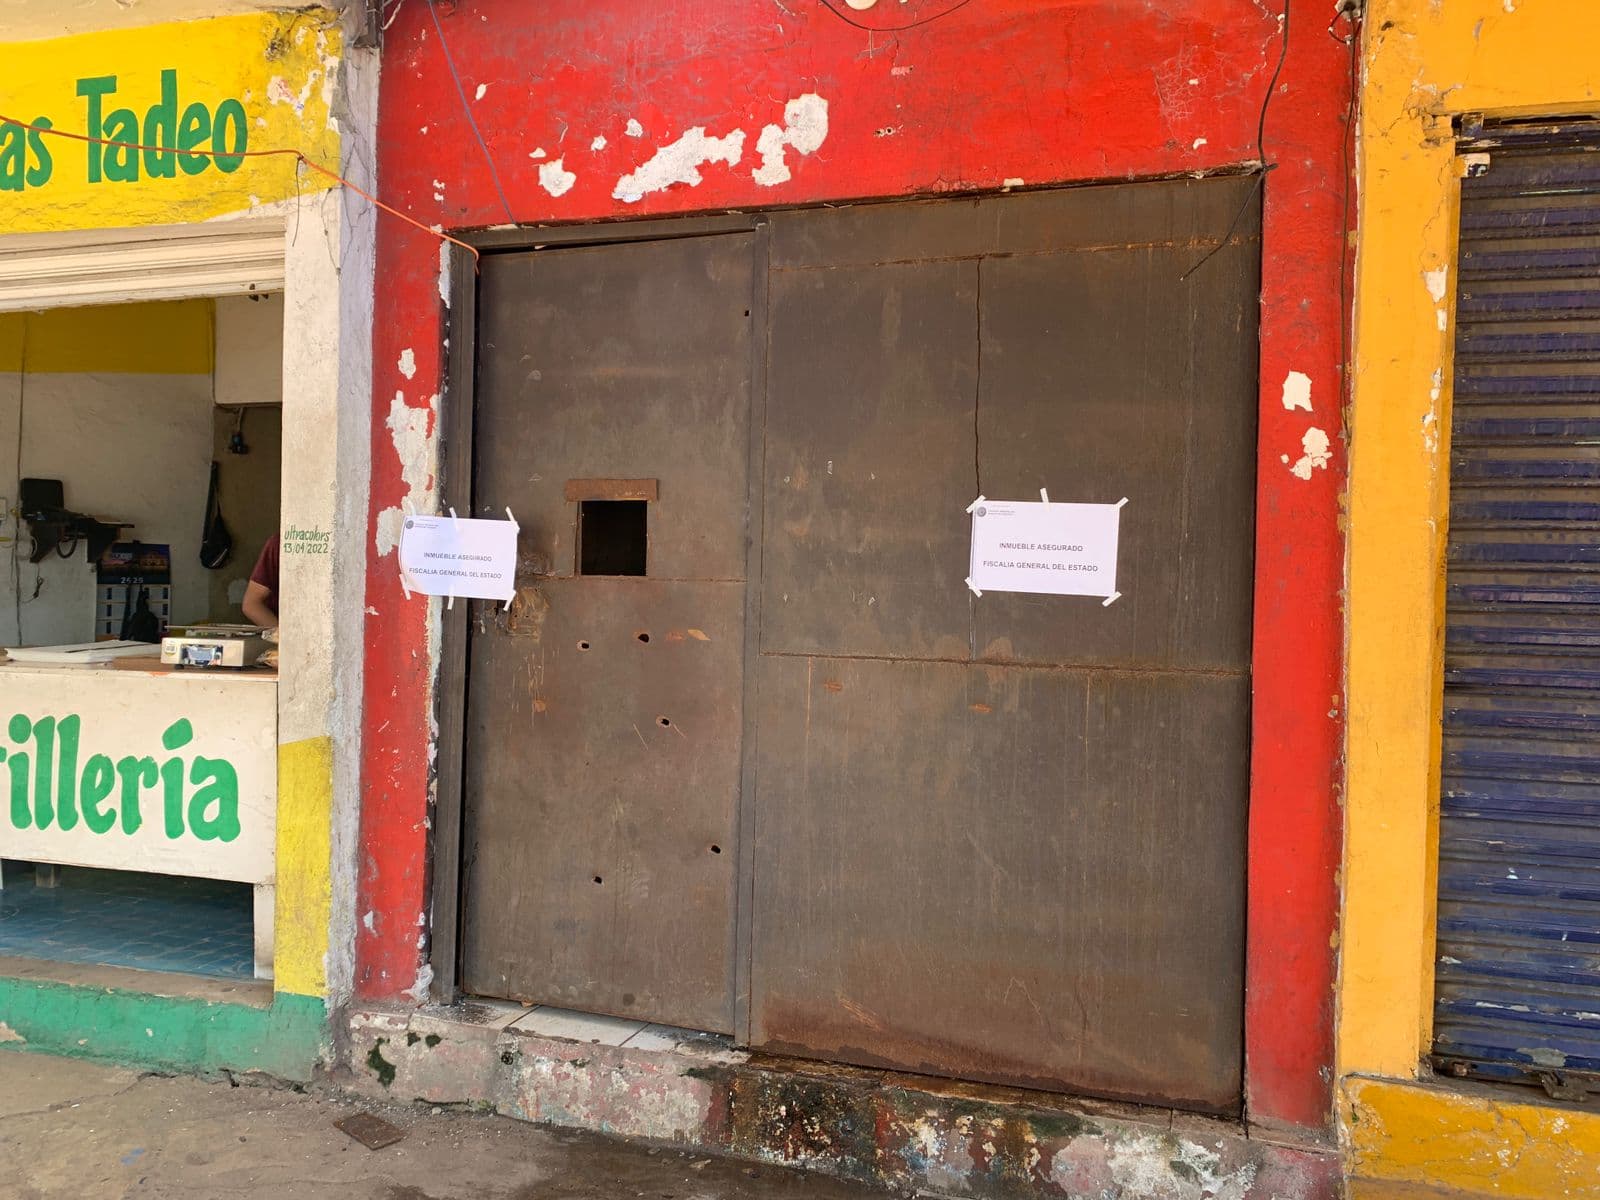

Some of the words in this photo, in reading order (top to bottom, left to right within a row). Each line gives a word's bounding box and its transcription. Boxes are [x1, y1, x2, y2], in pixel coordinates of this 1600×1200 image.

[76, 69, 248, 183] Tadeo
[999, 542, 1037, 551] INMUEBLE
[1037, 543, 1084, 552] ASEGURADO
[423, 552, 457, 560] INMUEBLE
[457, 554, 493, 562] ASEGURADO
[982, 560, 1015, 568] FISCALIA
[1016, 562, 1051, 570] GENERAL
[1052, 563, 1067, 571] DEL
[1067, 564, 1099, 572] ESTADO
[408, 567, 438, 575] FISCALIA
[438, 569, 468, 577] GENERAL
